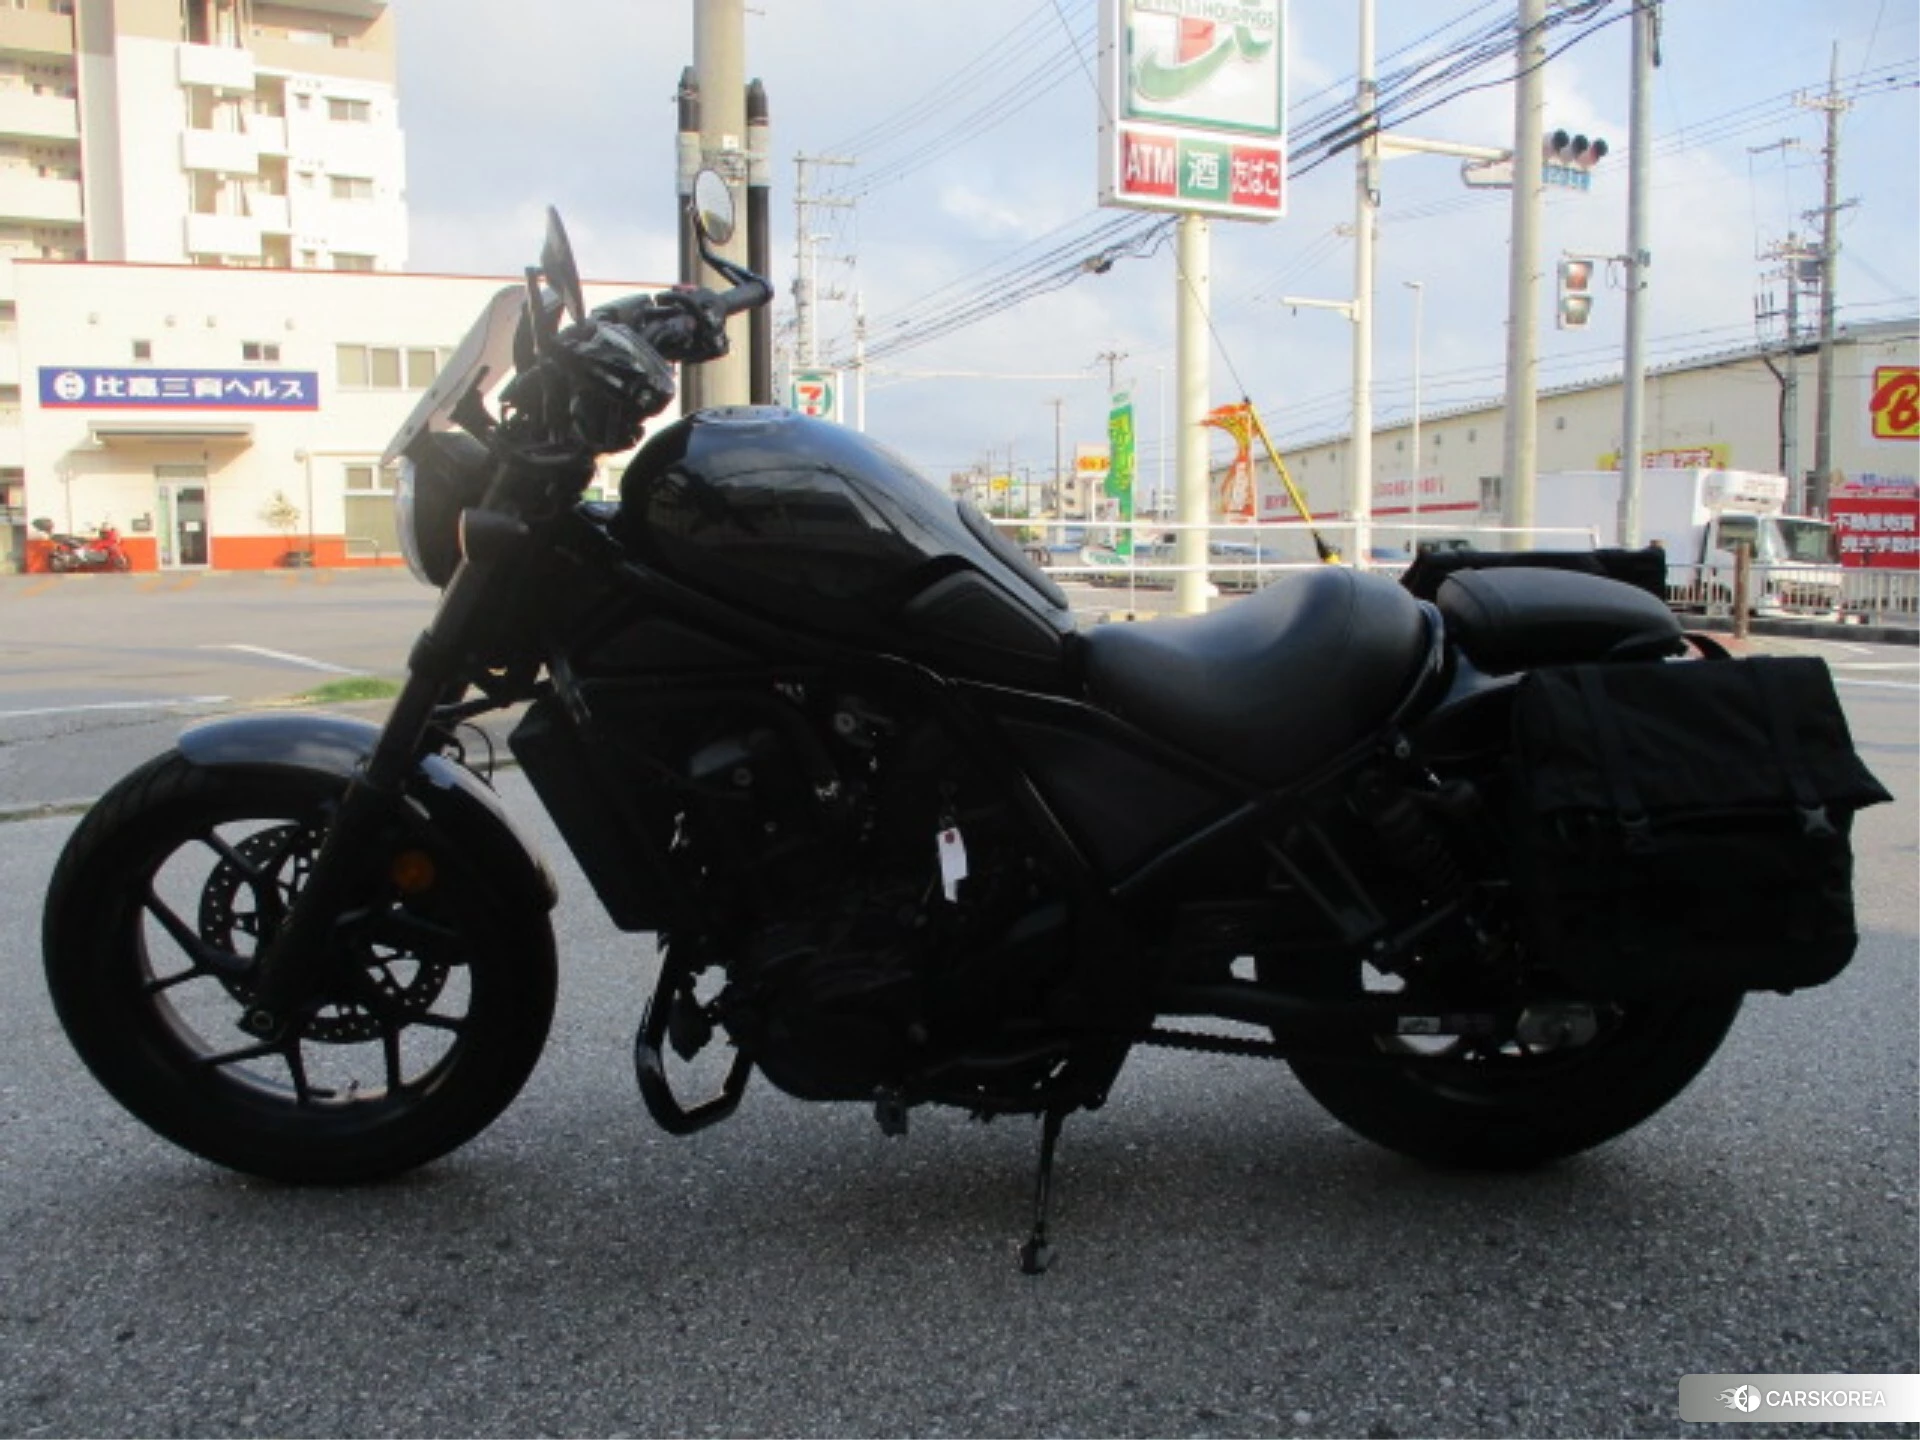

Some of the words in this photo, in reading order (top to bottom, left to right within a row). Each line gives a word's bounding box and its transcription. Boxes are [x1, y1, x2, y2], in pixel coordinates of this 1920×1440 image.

[1127, 143, 1174, 184] ATM
[1187, 150, 1220, 190] 酒
[1232, 157, 1279, 196] たばこ
